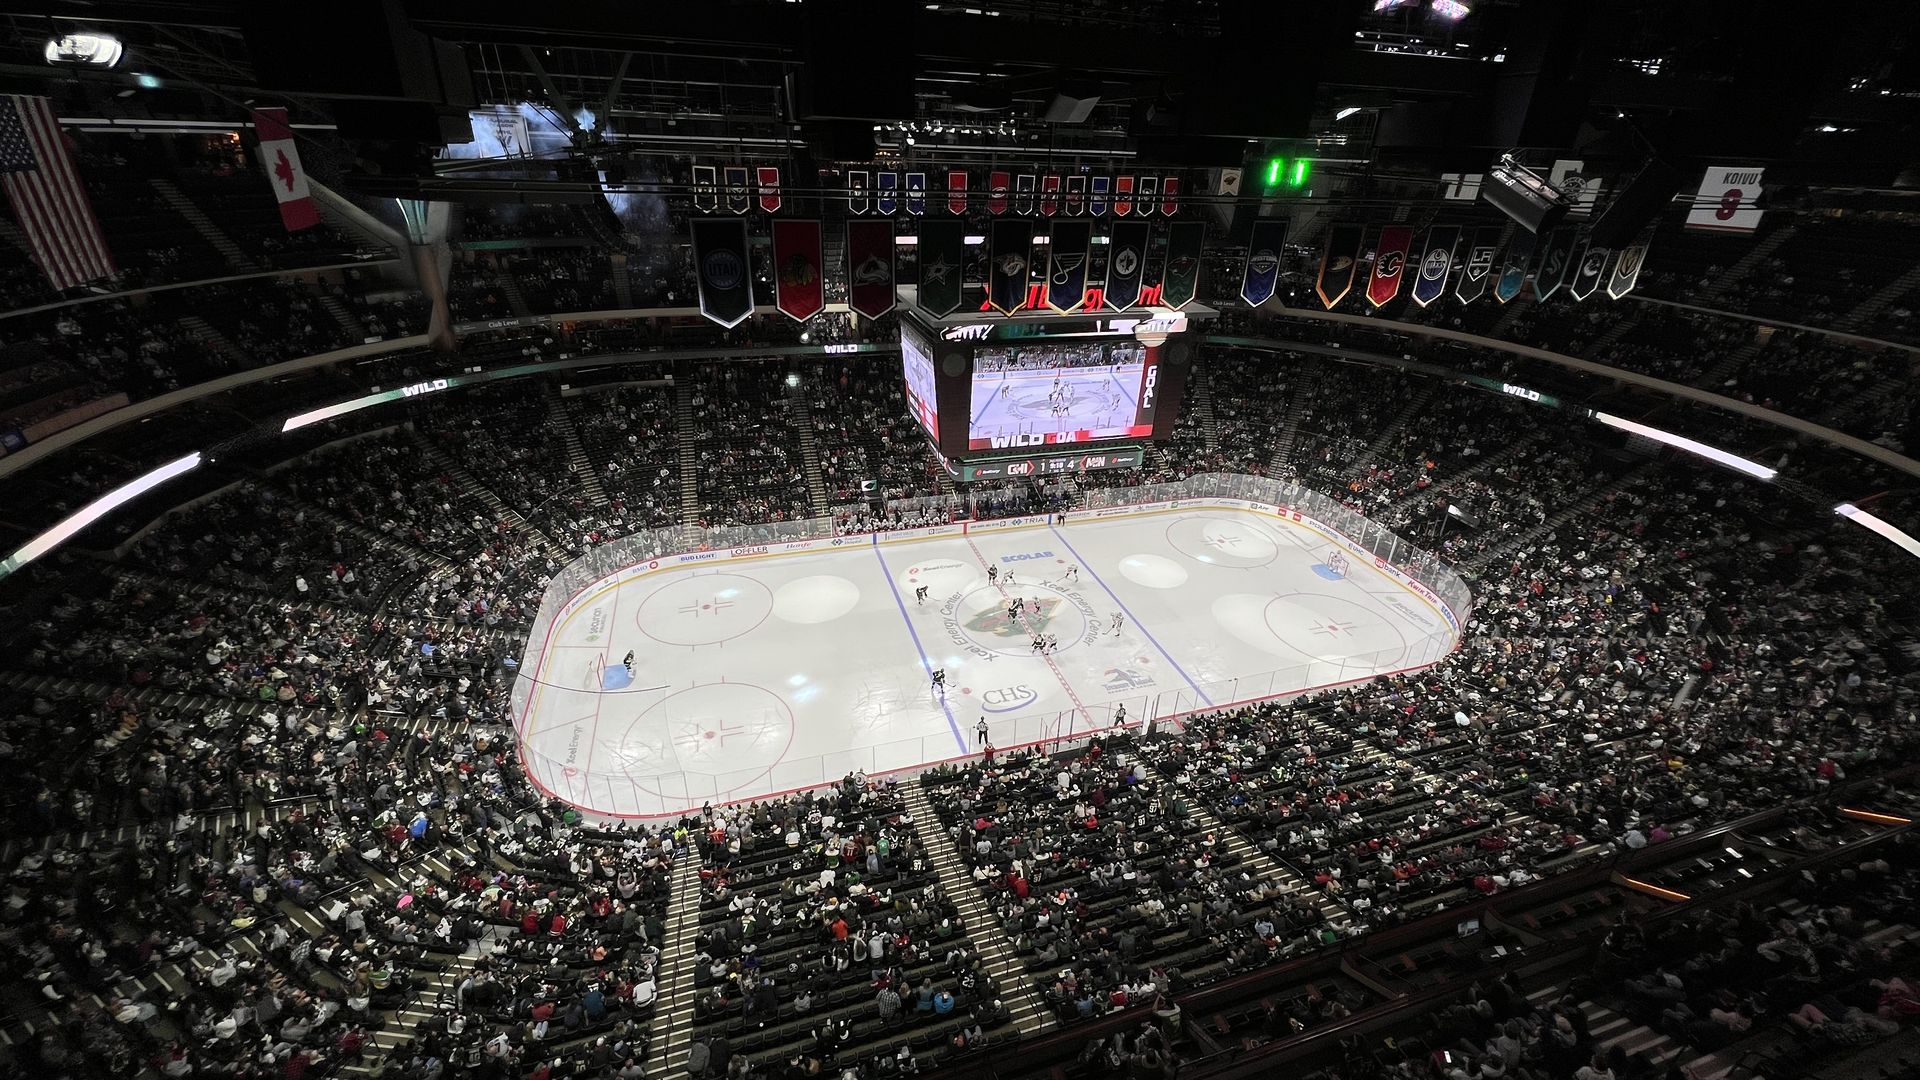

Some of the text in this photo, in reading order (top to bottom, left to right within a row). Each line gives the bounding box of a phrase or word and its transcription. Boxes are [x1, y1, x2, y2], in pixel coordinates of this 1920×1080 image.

[1723, 172, 1759, 185] KOIVU
[1473, 250, 1493, 262] LA
[488, 319, 520, 329] Club Level
[824, 343, 858, 354] WILD
[402, 379, 448, 397] WILD
[1143, 365, 1158, 409] GOAL
[1503, 383, 1540, 402] WILD
[990, 433, 1045, 449] WILD
[1067, 459, 1075, 469] 4
[697, 552, 715, 561] LIGHT
[730, 545, 769, 556] LOFFLER
[1000, 550, 1055, 563] ECOLAB
[1384, 563, 1401, 578] bank
[1039, 579, 1103, 647] Xcel Energy Center
[940, 591, 1000, 663] Xcel Energy Center
[983, 684, 1032, 705] CHS
[962, 976, 975, 988] 23
